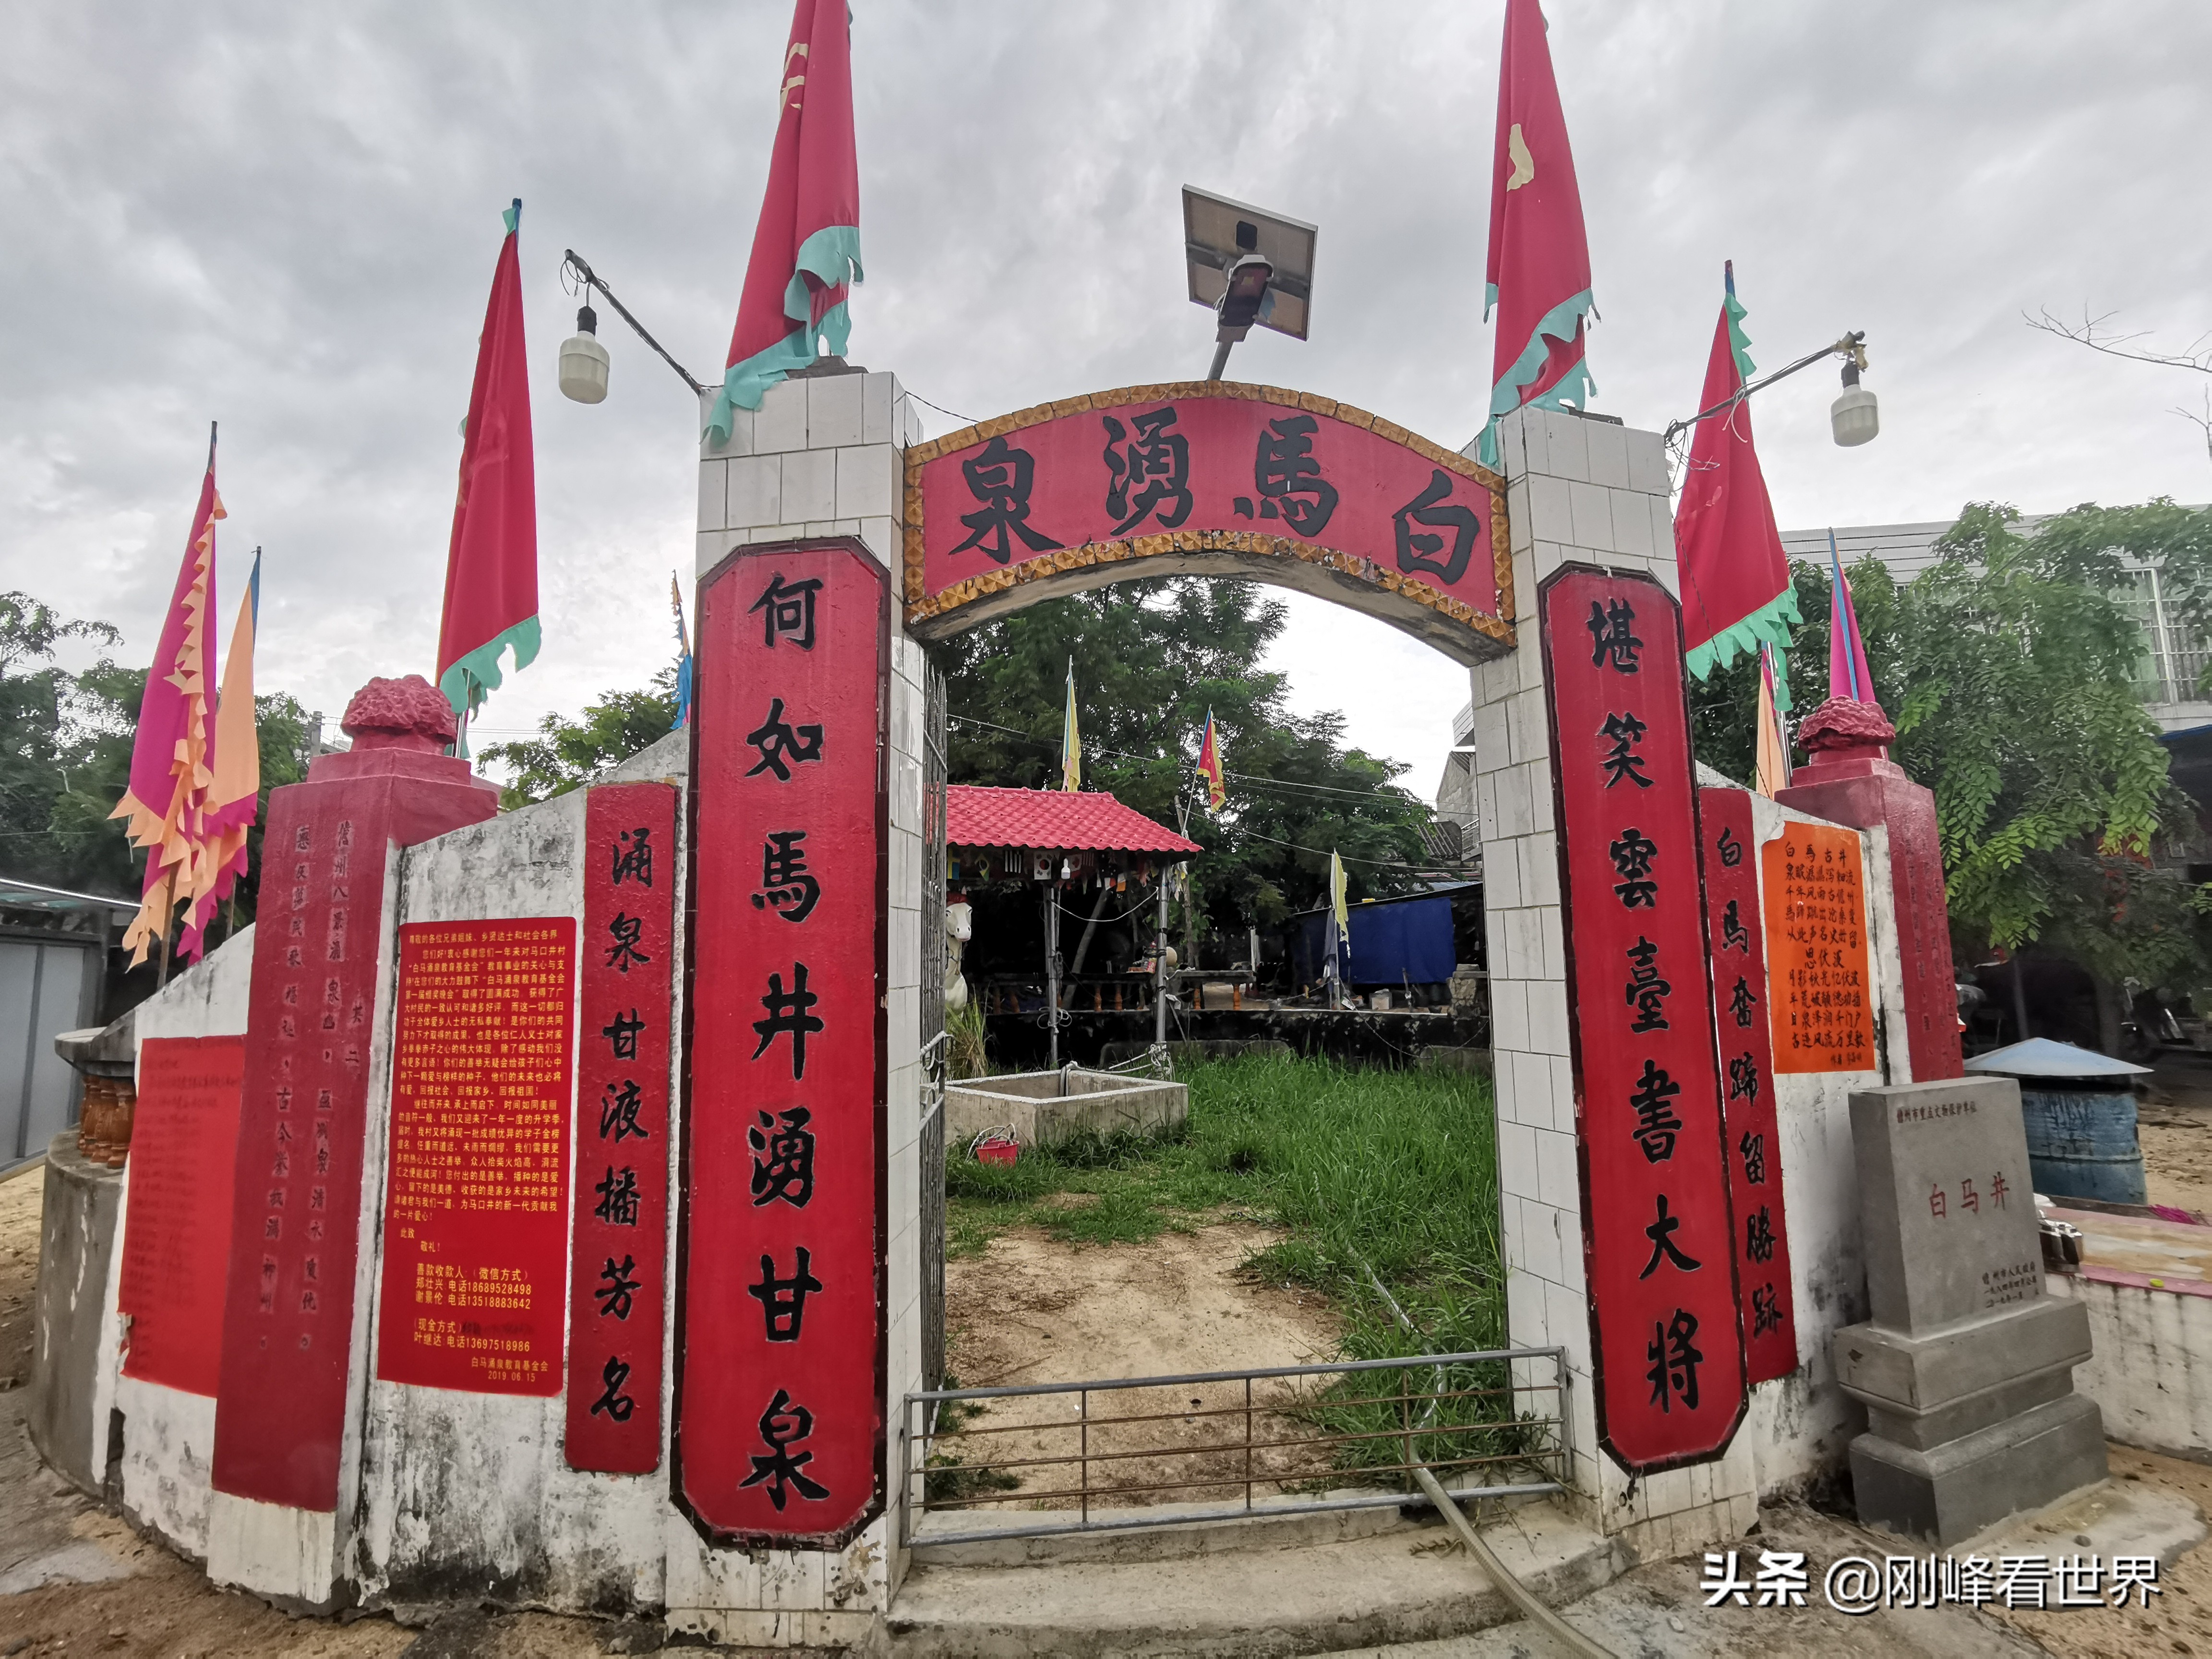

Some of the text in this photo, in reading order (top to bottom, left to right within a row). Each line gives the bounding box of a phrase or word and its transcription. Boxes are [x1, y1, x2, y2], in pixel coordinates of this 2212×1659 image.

[948, 407, 1479, 585] 白馬湧泉
[590, 827, 652, 1423] 涌泉甘液播芳名
[739, 575, 830, 1513] 何如馬井湧甘泉
[1587, 599, 1703, 1412] 堪笑雲臺書大將
[1929, 1171, 2010, 1218] 白马井
[400, 1228, 414, 1238] 此致
